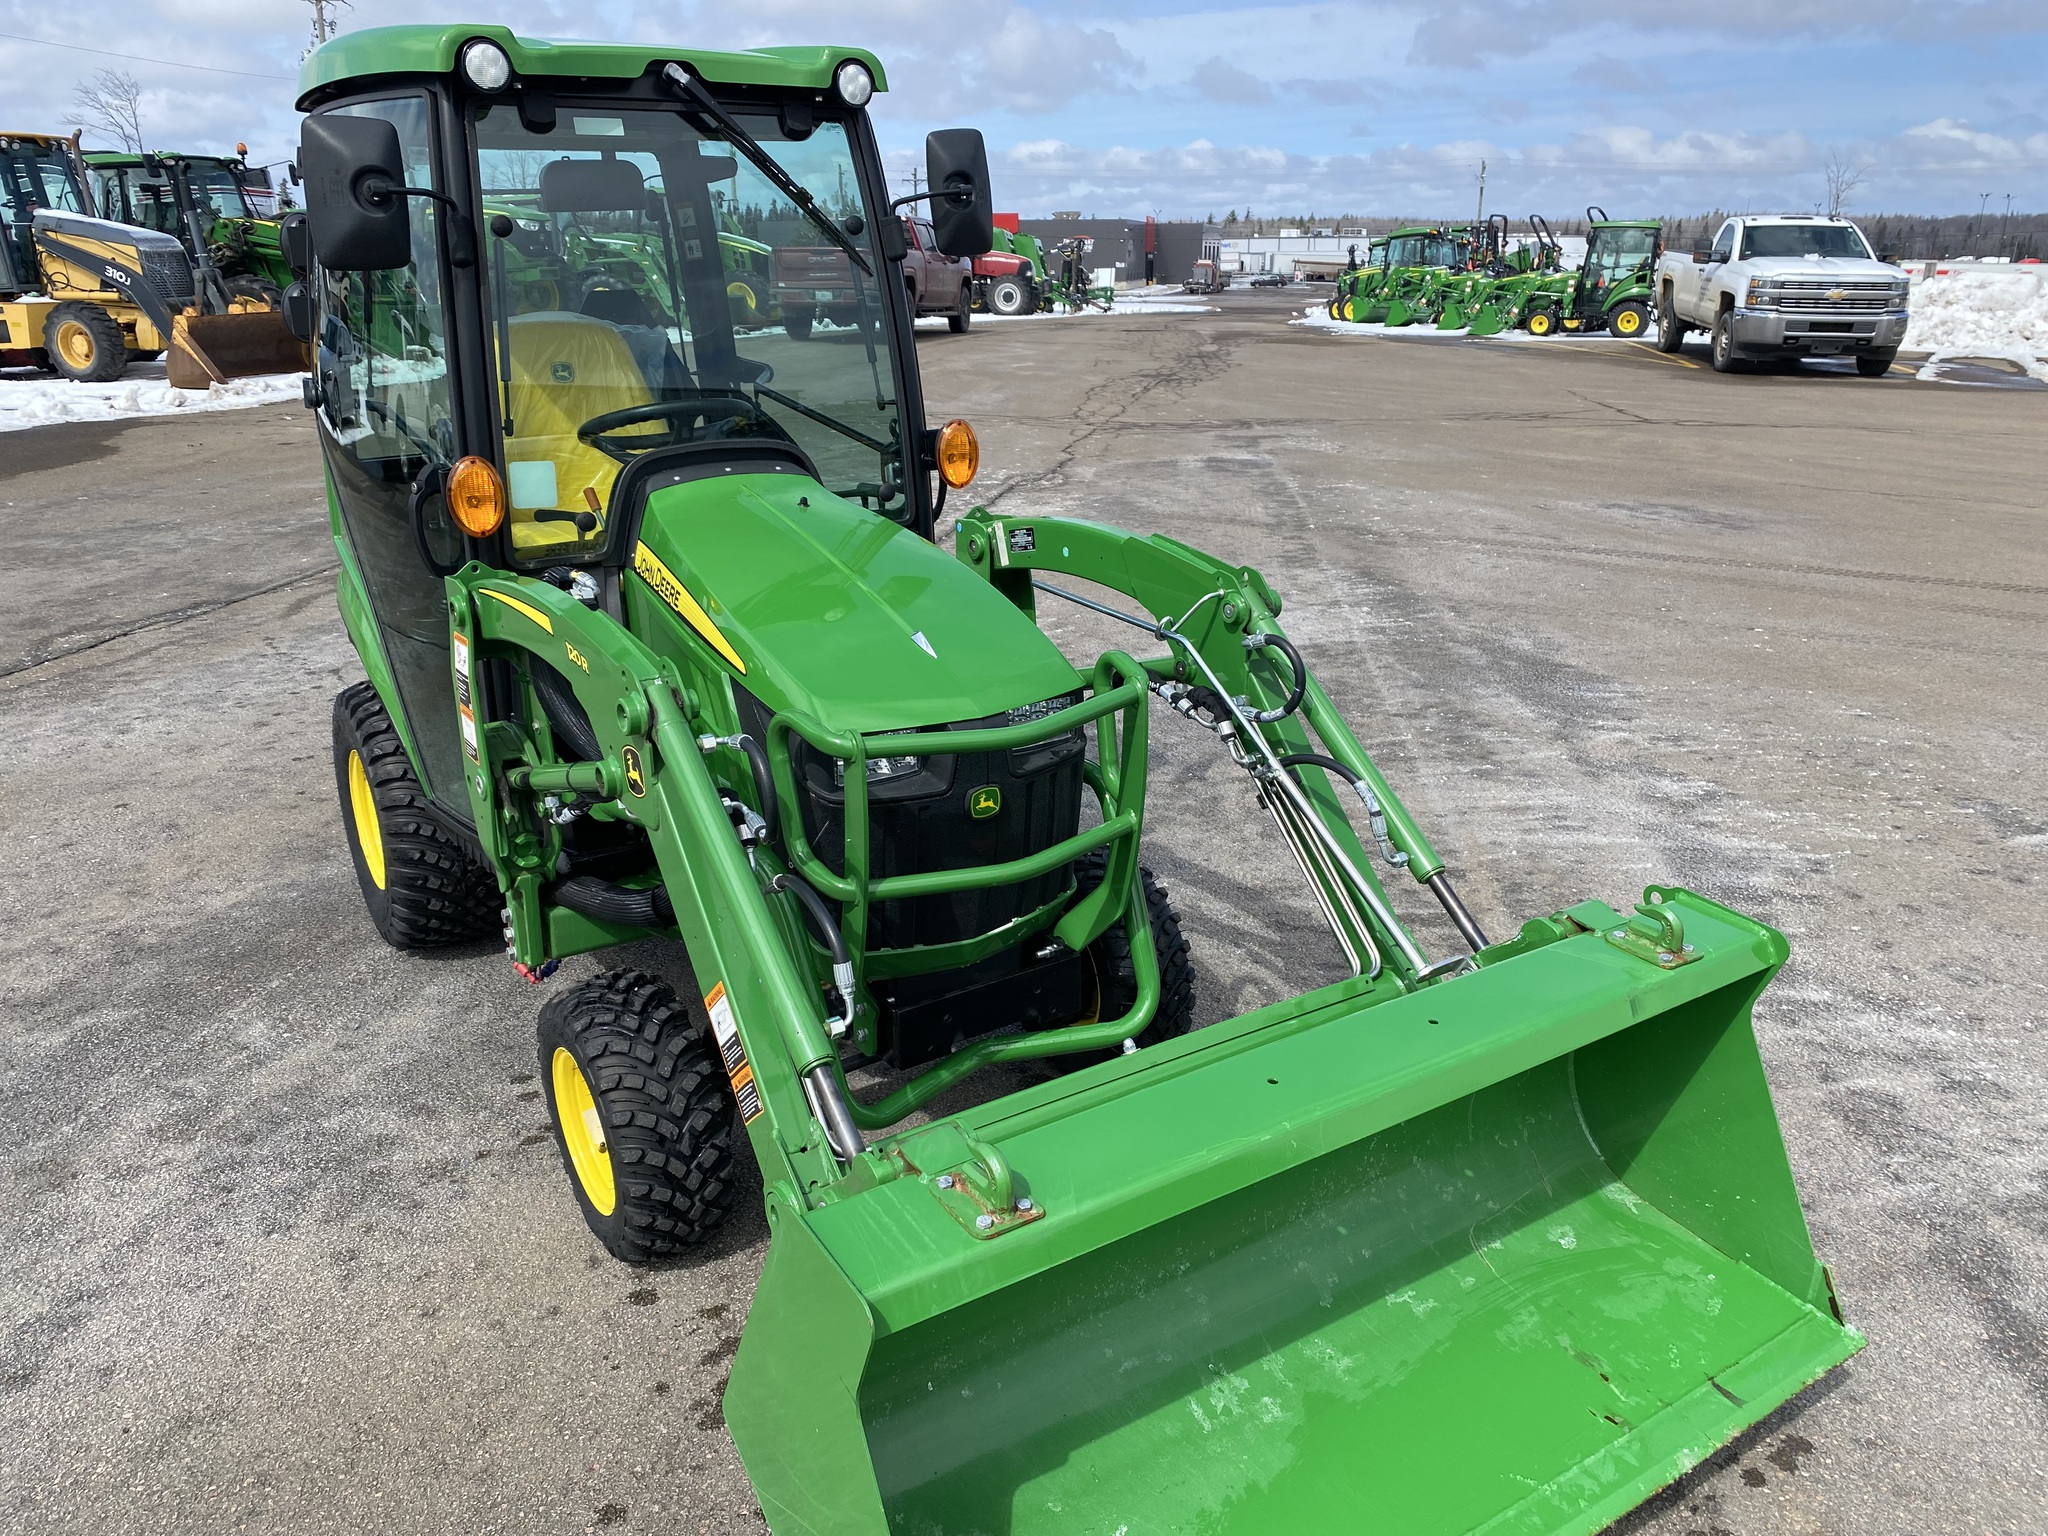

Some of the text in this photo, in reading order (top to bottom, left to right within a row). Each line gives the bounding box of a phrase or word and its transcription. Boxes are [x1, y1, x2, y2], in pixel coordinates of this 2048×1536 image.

[104, 265, 131, 286] 310J
[637, 552, 681, 609] JOHN DEERE
